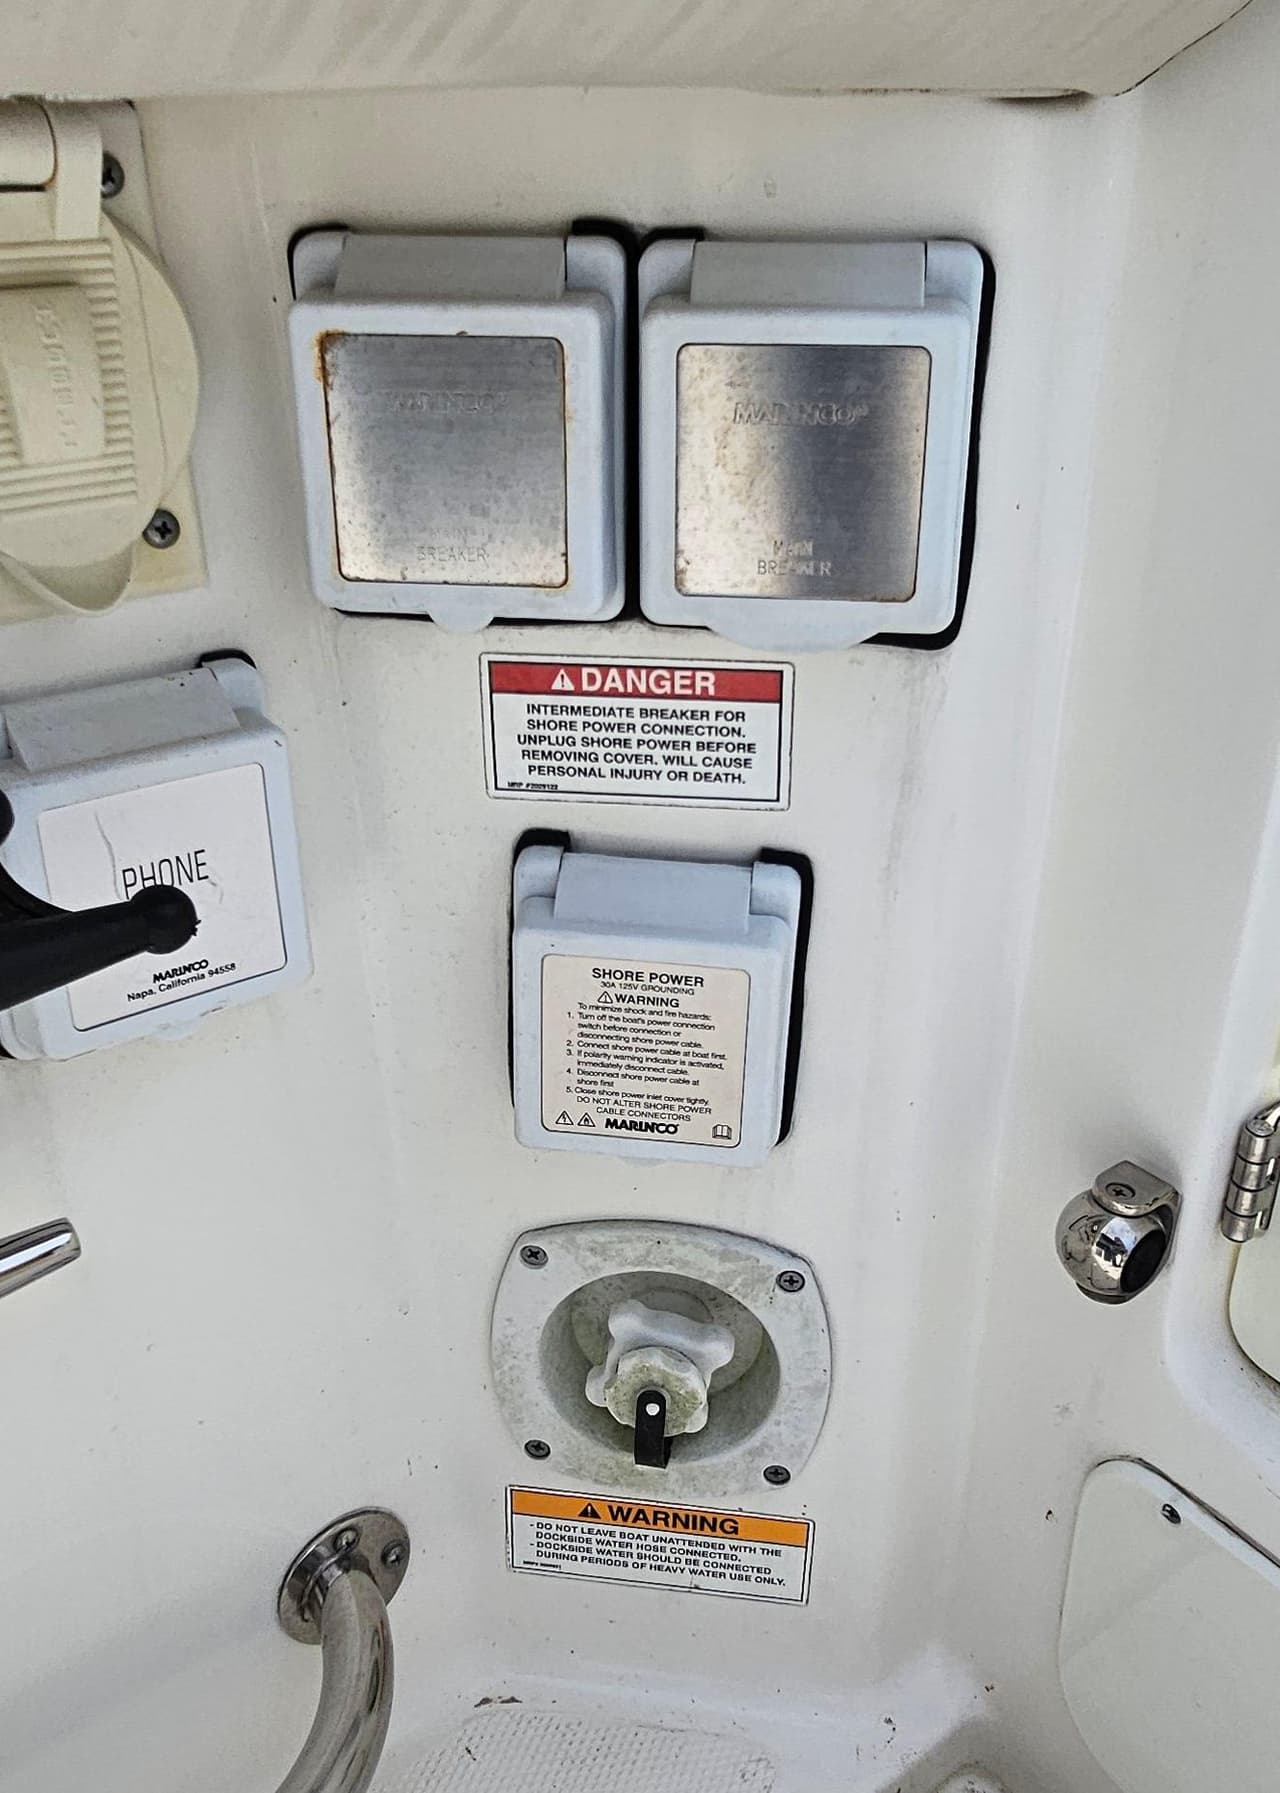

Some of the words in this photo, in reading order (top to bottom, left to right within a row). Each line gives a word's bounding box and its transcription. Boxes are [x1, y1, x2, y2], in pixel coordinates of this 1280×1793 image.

[581, 667, 716, 696] DANGER
[526, 703, 635, 719] INTERMEDIATE
[639, 708, 710, 722] BREAKER
[714, 710, 746, 722] FOR
[527, 719, 578, 732] SHORE
[582, 721, 636, 734] POWER
[640, 723, 746, 738] CONNECTION.
[517, 734, 576, 748] UNPLUG
[581, 736, 632, 750] SHORE
[636, 738, 691, 752] POWER
[695, 740, 756, 754] BEFORE
[521, 749, 599, 764] REMOVING
[603, 752, 658, 766] COVER.
[662, 755, 698, 768] WILL
[702, 756, 753, 770] CAUSE
[528, 764, 606, 779] PERSONAL
[610, 768, 662, 781] INJURY
[666, 770, 689, 782] OR
[693, 771, 746, 784] DEATH.
[122, 849, 209, 900] PHONE
[153, 959, 208, 984] MARINCO
[158, 973, 206, 992] California
[208, 962, 236, 977] 94558
[592, 968, 645, 982] SHORE
[649, 972, 704, 987] POWER
[600, 981, 616, 989] 30A
[620, 983, 640, 991] 125V
[640, 984, 695, 996] GROUNDING
[614, 992, 680, 1008] WARNING
[578, 1002, 588, 1010] To
[588, 1004, 622, 1013] minimize
[624, 1008, 646, 1016] shock
[665, 1010, 677, 1018] fire
[578, 1012, 595, 1020] Turn
[622, 1016, 646, 1024] boat's
[672, 1022, 716, 1031] connection
[578, 1022, 602, 1030] switch
[603, 1024, 628, 1032] before
[629, 1026, 672, 1036] connection
[577, 1032, 630, 1044] disconnecting
[632, 1036, 654, 1044] shore
[577, 1040, 610, 1050] Connect
[612, 1044, 634, 1052] shore
[634, 1046, 658, 1054] power
[660, 1048, 681, 1056] cable
[692, 1051, 710, 1059] boat
[584, 1051, 612, 1061] polarity
[613, 1054, 644, 1064] warning
[646, 1056, 678, 1065] indicator
[577, 1068, 620, 1078] Disconnect
[620, 1073, 642, 1081] shore
[670, 1078, 690, 1086] cable
[624, 1064, 666, 1074] disconnect
[574, 1086, 596, 1095] Close
[577, 1096, 590, 1104] DO
[613, 1100, 641, 1108] ALTER
[644, 1102, 676, 1111] SHORE
[678, 1105, 712, 1114] POWER
[596, 1106, 626, 1116] CABLE
[628, 1110, 692, 1122] CONNECTORS
[605, 1118, 679, 1134] MARINCO
[608, 1504, 739, 1535] WARNING
[536, 1532, 592, 1544] DOCKSIDE
[596, 1538, 632, 1550] WATER
[636, 1544, 666, 1553] HOSE
[670, 1547, 742, 1562] CONNECTED.
[556, 1524, 578, 1533] NOT
[581, 1526, 616, 1538] LEAVE
[620, 1532, 650, 1541] BOAT
[652, 1536, 726, 1550] UNATTENDED
[728, 1544, 756, 1554] WITH
[760, 1548, 782, 1557] THE
[536, 1550, 578, 1562] DURING
[580, 1556, 628, 1568] PERIODS
[632, 1562, 647, 1570] OF
[650, 1564, 686, 1574] HEAVY
[688, 1568, 726, 1579] WATER
[729, 1572, 752, 1582] USE
[754, 1576, 786, 1586] ONLY.
[596, 1548, 634, 1559] WATER
[636, 1552, 682, 1564] SHOULD
[685, 1558, 700, 1566] BE
[703, 1560, 772, 1575] CONNECTED
